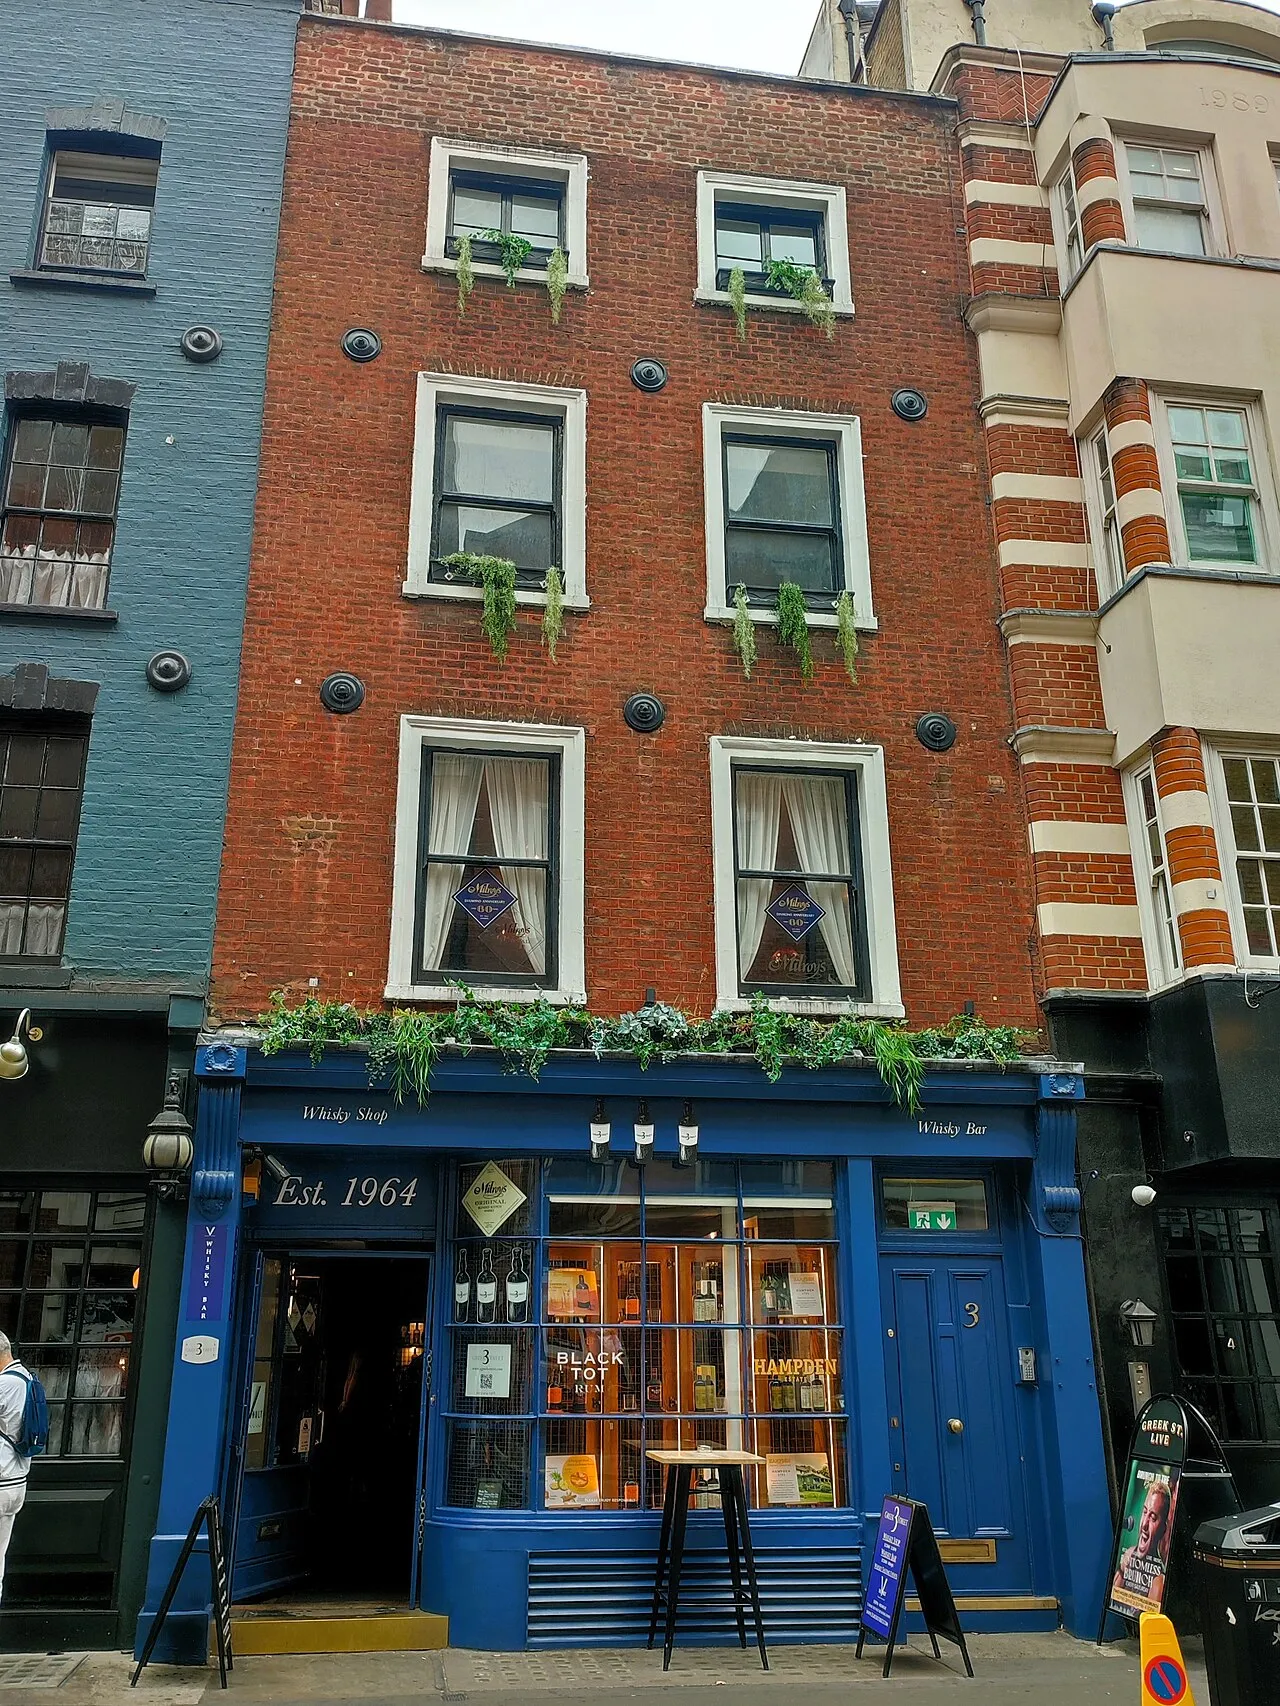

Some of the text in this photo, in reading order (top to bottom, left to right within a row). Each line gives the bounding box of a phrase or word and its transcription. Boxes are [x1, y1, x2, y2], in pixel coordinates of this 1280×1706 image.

[1199, 87, 1270, 114] 1989
[303, 1105, 388, 1125] Whisky Shop
[918, 1120, 987, 1138] Whisky Bar
[272, 1176, 419, 1207] Est. 1964
[203, 1240, 213, 1287] WHISKY
[200, 1296, 208, 1319] BAR
[963, 1302, 980, 1328] 3
[195, 1342, 203, 1356] 3
[1227, 1337, 1236, 1350] 4
[482, 1349, 490, 1365] 3
[556, 1352, 624, 1365] BLACK
[570, 1367, 609, 1380] TOT
[753, 1358, 837, 1375] HAMPDEN
[574, 1384, 605, 1394] RUM
[1141, 1419, 1184, 1438] GREEK ST.
[1150, 1432, 1171, 1447] LIVE
[1123, 1567, 1154, 1588] BRUNCH
